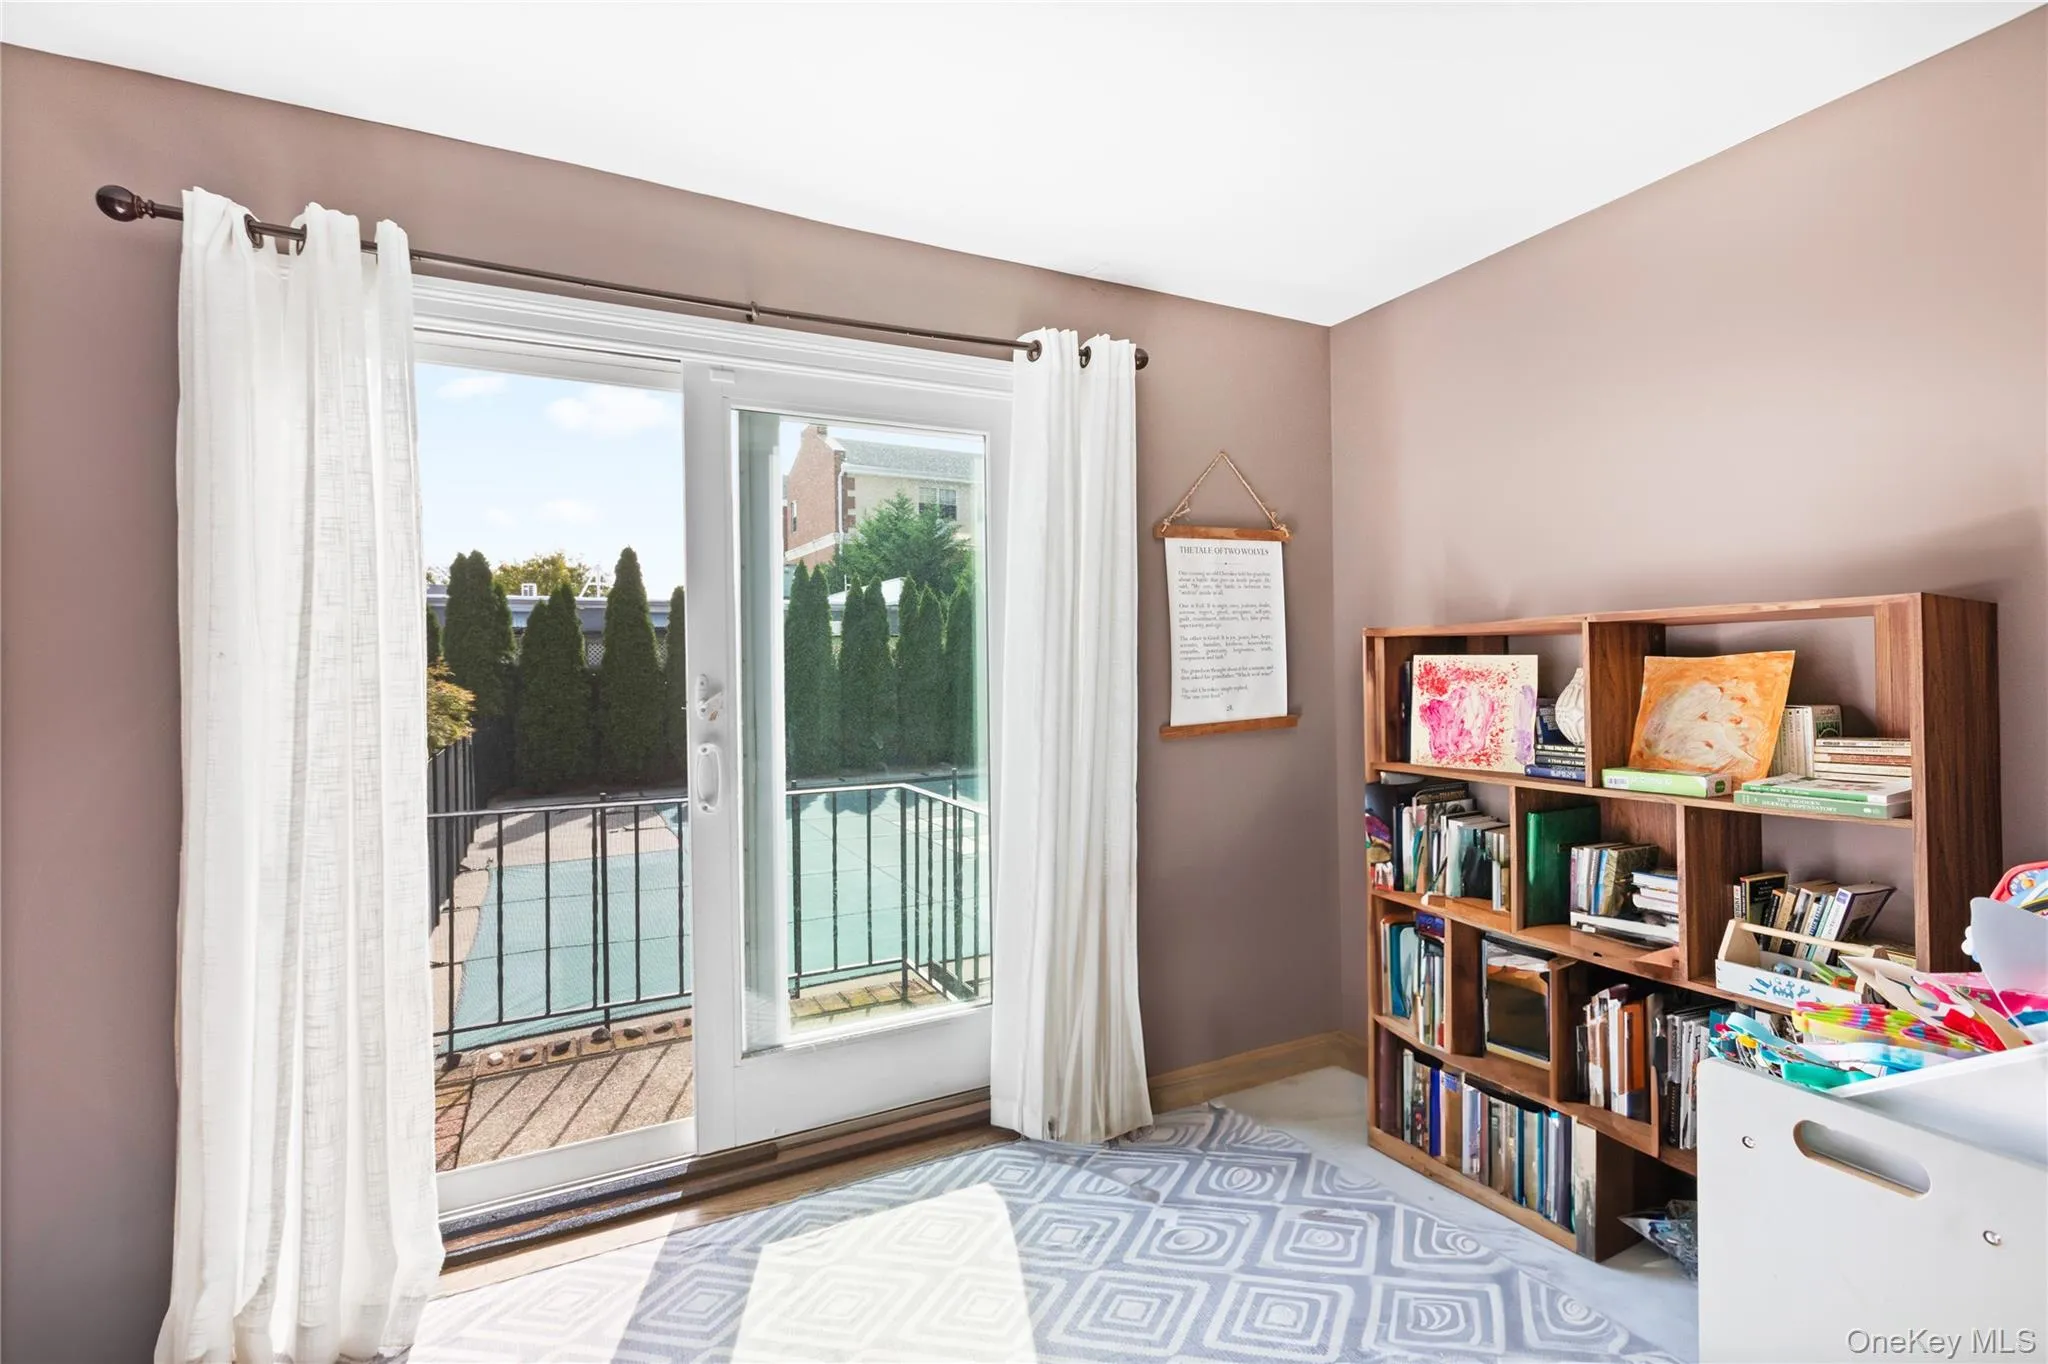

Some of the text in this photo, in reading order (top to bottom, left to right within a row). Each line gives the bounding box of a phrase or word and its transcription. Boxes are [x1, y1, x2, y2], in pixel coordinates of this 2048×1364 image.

[1179, 546, 1269, 556] THE TALE OF TWO WOLVES
